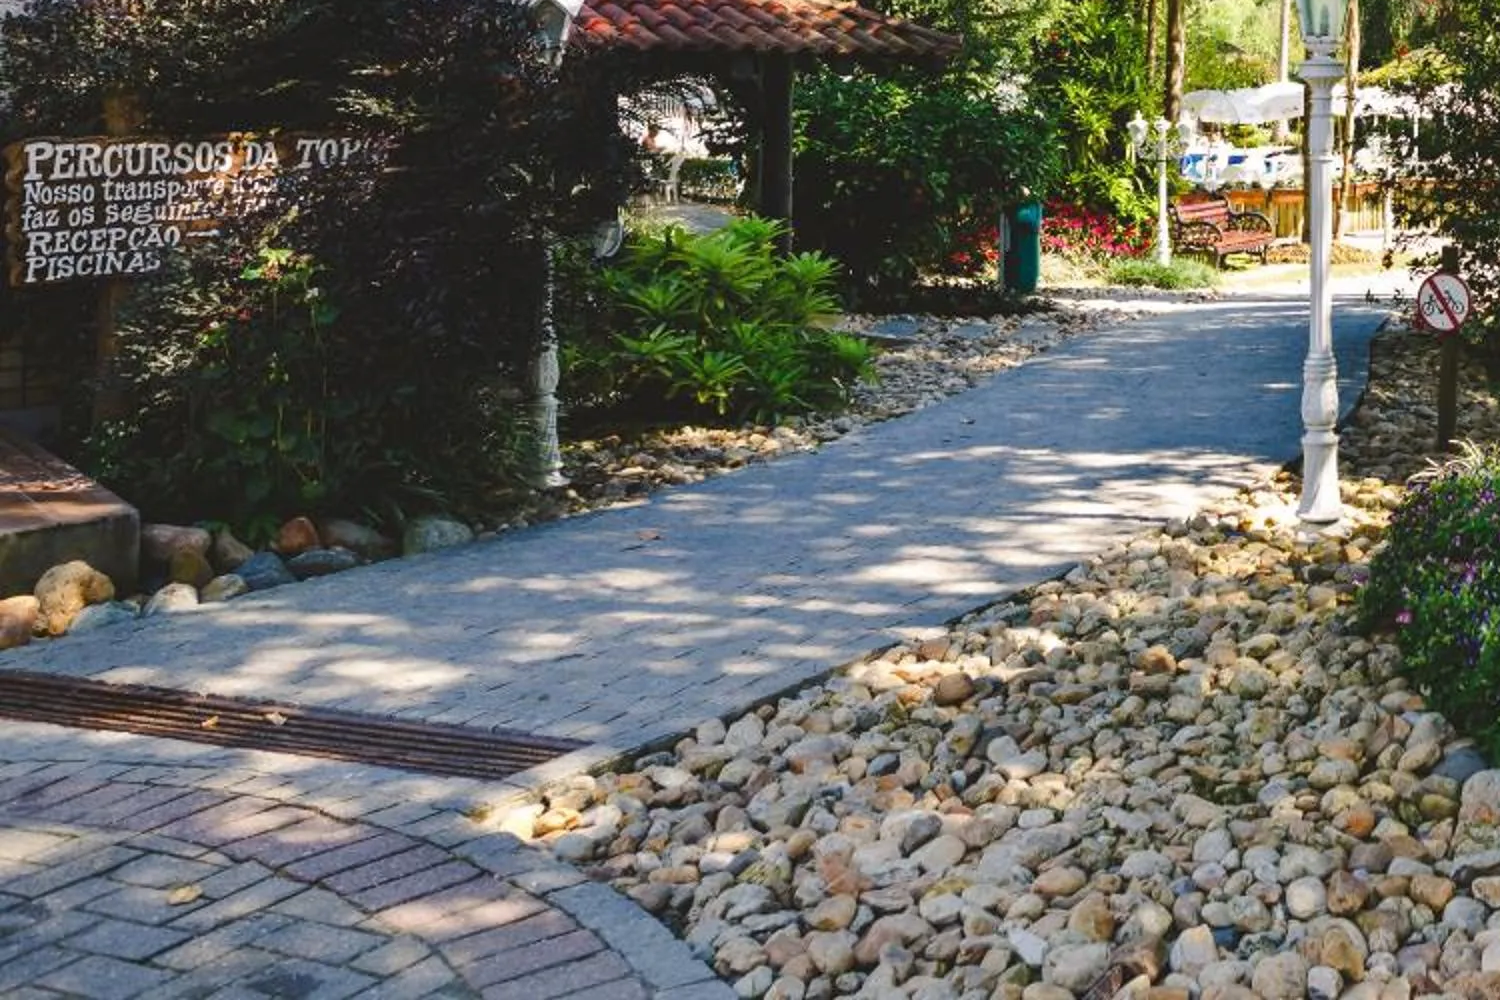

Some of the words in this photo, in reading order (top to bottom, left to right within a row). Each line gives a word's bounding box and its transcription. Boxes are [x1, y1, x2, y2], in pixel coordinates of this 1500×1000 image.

[23, 141, 233, 181] PERCURSOS
[241, 141, 279, 172] DA
[23, 179, 95, 207] Nosso
[22, 203, 60, 231] faz
[68, 205, 95, 227] os
